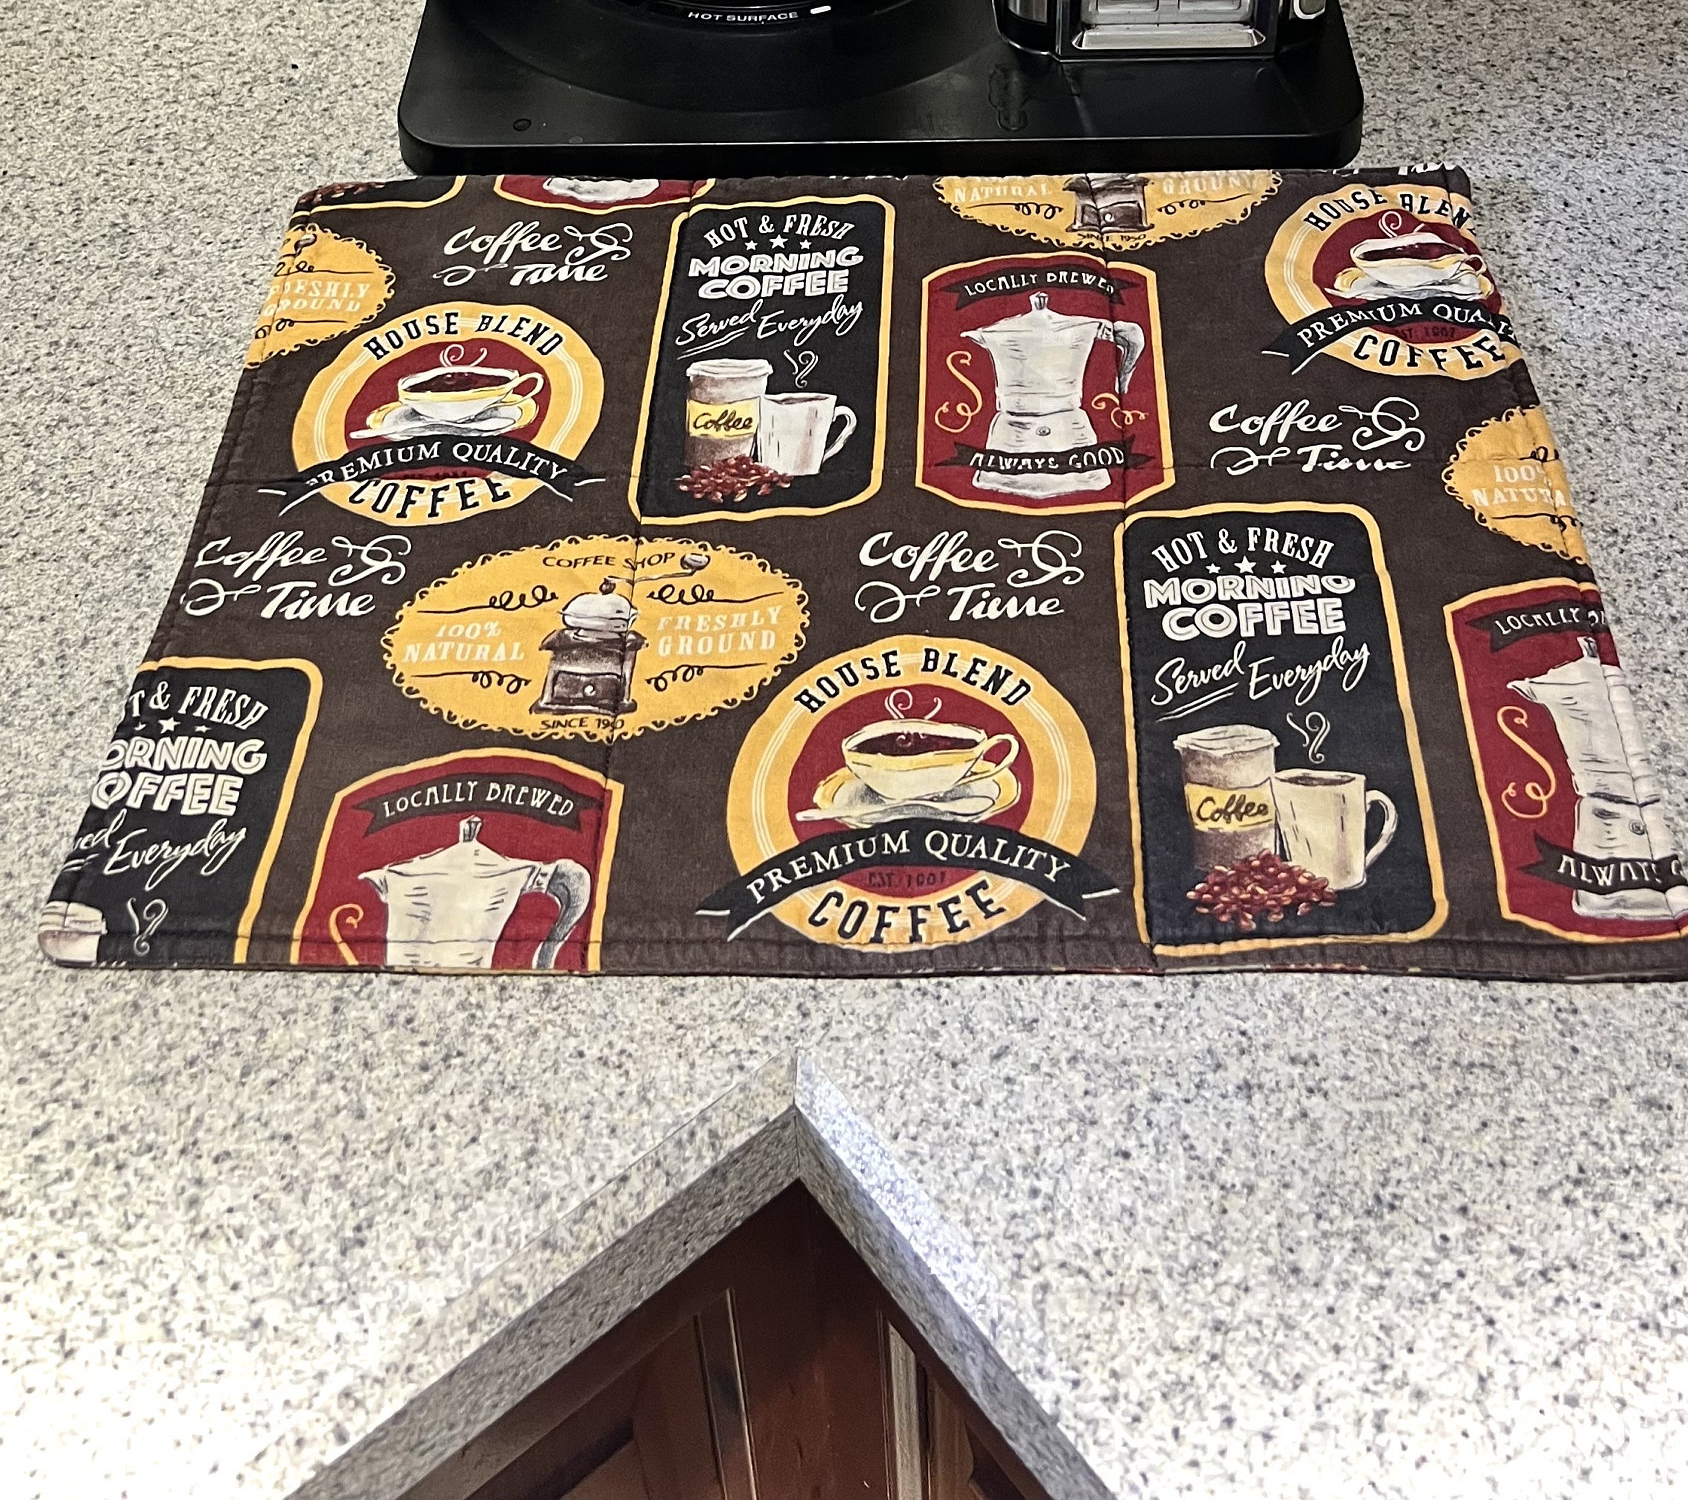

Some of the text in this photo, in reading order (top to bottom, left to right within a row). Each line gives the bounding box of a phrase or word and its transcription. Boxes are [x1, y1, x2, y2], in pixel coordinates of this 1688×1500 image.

[687, 11, 799, 22] HOT SURFACE
[954, 183, 1053, 203] NATURAL
[1303, 189, 1477, 236] HOUSE BLEN
[443, 221, 562, 264] Coffee
[703, 214, 856, 249] HOT & FRESH
[509, 263, 608, 286] Time
[688, 246, 864, 279] MORNING
[698, 269, 850, 300] COFFEE
[964, 271, 1115, 297] LOCALLY BREWED
[362, 312, 564, 361] HOUSE BLEND
[675, 294, 863, 347] Served Everyday
[1297, 303, 1423, 349] PREMIUM
[1353, 333, 1506, 370] COFFEE
[693, 409, 753, 433] Coffee
[1209, 399, 1343, 445] Coffee
[452, 442, 568, 478] QUALITY
[969, 446, 1125, 471] ALWAYS GOOD
[1297, 444, 1412, 473] Time
[348, 477, 511, 519] COFFEE
[1471, 487, 1567, 507] NATURA
[194, 530, 328, 581] Coffee
[542, 553, 675, 571] COFFEE SHOP
[859, 530, 1000, 581] Coffee
[1152, 526, 1334, 573] HOT & FRESH
[260, 581, 376, 621] Time
[947, 581, 1065, 622] Time
[1144, 573, 1356, 609] MORNING
[436, 619, 503, 638] 100%
[656, 605, 783, 632] FRESHLY
[1161, 597, 1347, 641] COFFEE
[1495, 607, 1580, 635] LOCALLY
[403, 637, 526, 663] NATURAL
[658, 629, 776, 658] GROUND
[794, 647, 1033, 714] HOUSE BLEND
[1151, 635, 1370, 707] Served Everyday
[149, 680, 171, 710] &
[178, 686, 268, 730] FRESH
[541, 717, 589, 729] SINCE
[100, 735, 268, 774] ORNING
[91, 770, 244, 816] OFFEE
[383, 781, 575, 818] LOCALLY BREWED
[1196, 794, 1270, 822] Coffee
[103, 818, 247, 891] Everyday
[745, 829, 1071, 904] PREMIUM QUALITY
[807, 877, 1008, 944] COFFEE
